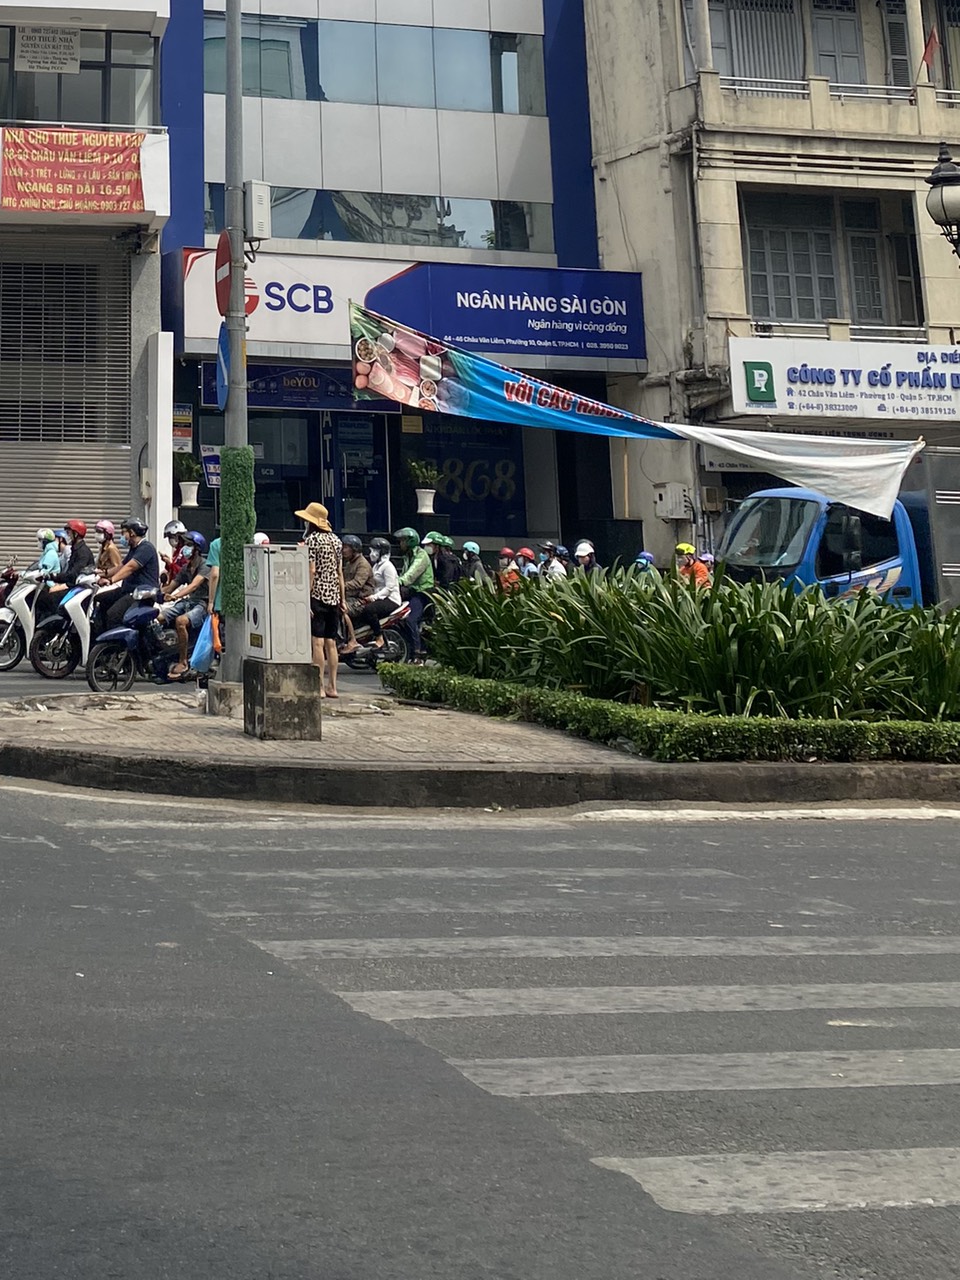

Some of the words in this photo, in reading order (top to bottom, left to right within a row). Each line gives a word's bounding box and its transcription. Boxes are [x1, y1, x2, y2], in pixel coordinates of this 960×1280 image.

[28, 131, 49, 145] CHO
[82, 132, 122, 147] NGUYÊN
[31, 148, 55, 161] CHÂU
[17, 182, 54, 193] NGANG
[76, 183, 95, 195] DÀI
[100, 185, 131, 195] 16.5M
[265, 282, 334, 313] SCB
[456, 290, 505, 310] NGÂN
[509, 292, 557, 313] HÀNG
[560, 295, 587, 314] SÀI
[590, 296, 627, 316] GÒN
[528, 320, 551, 331] Ngân
[553, 321, 574, 332] hàng
[575, 321, 583, 330] vì
[583, 322, 605, 333] cộng
[605, 322, 627, 334] đồng
[506, 338, 528, 347] Phường
[536, 339, 552, 347] Quận
[917, 351, 938, 365] ĐỊA
[282, 375, 321, 389] beYOU
[787, 363, 835, 385] CÔNG
[840, 369, 863, 385] TY
[896, 366, 946, 389] PHẦN
[503, 378, 534, 404] VỚI
[860, 392, 886, 400] Phường
[900, 393, 917, 402] Quận
[927, 394, 952, 402] TP.HCM
[323, 410, 335, 498] ATM
